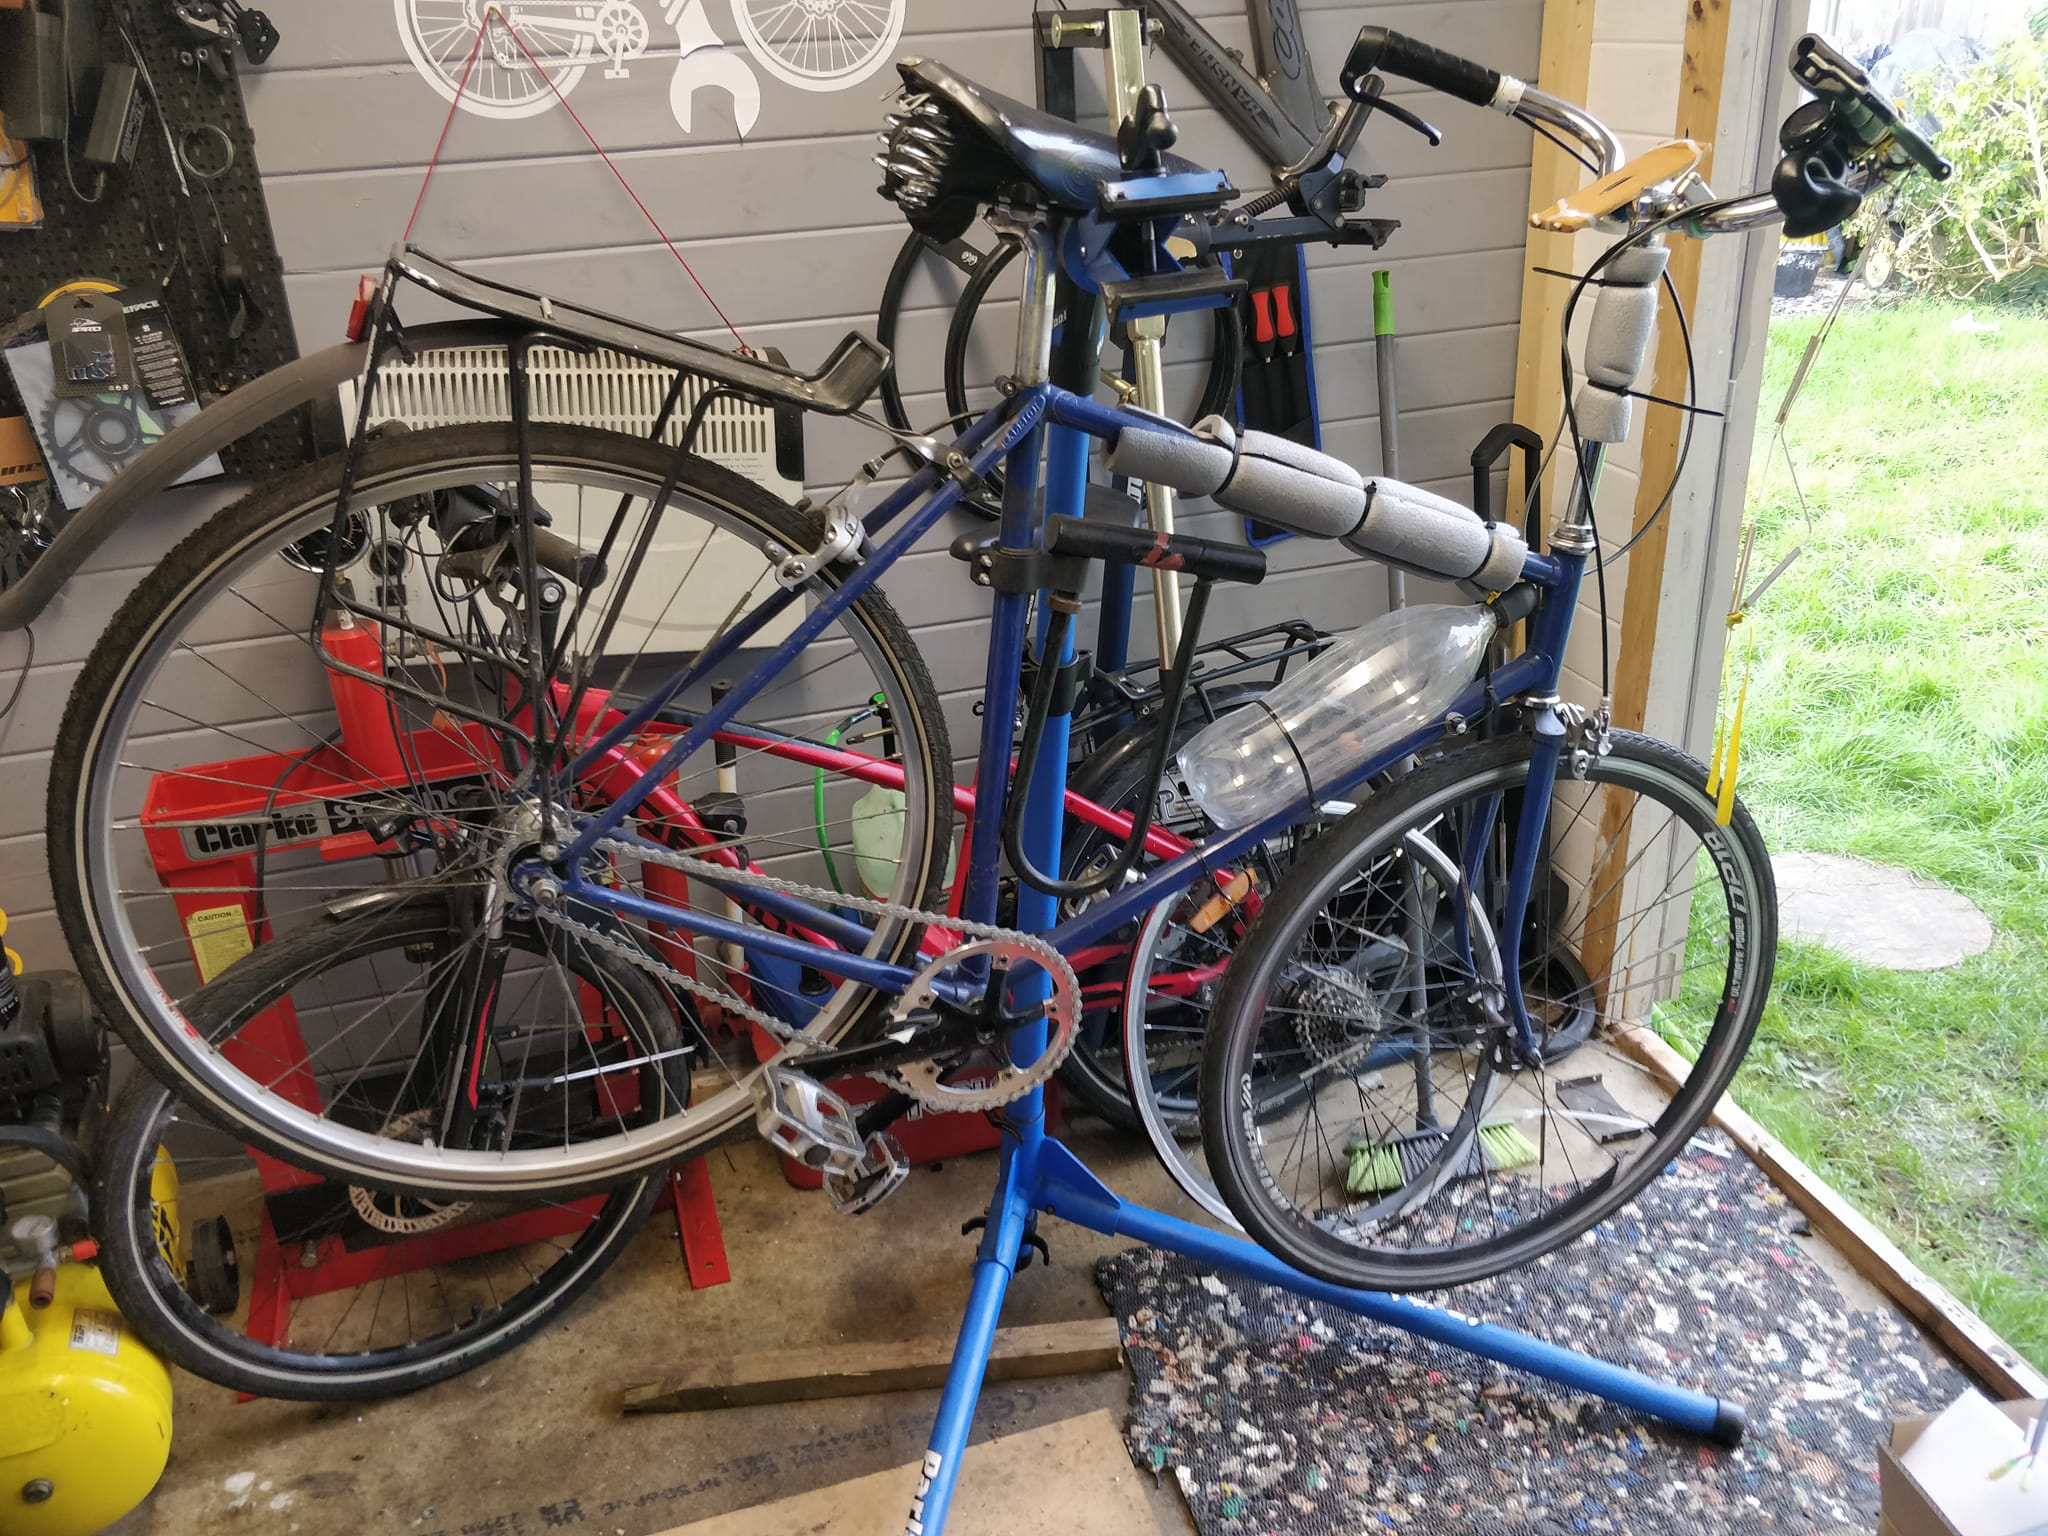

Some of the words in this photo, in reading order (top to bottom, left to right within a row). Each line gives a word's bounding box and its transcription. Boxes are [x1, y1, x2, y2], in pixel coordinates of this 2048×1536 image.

[197, 911, 232, 922] CAUTION
[1734, 916, 1745, 949] POWER
[1730, 950, 1745, 998] ULTIMATE
